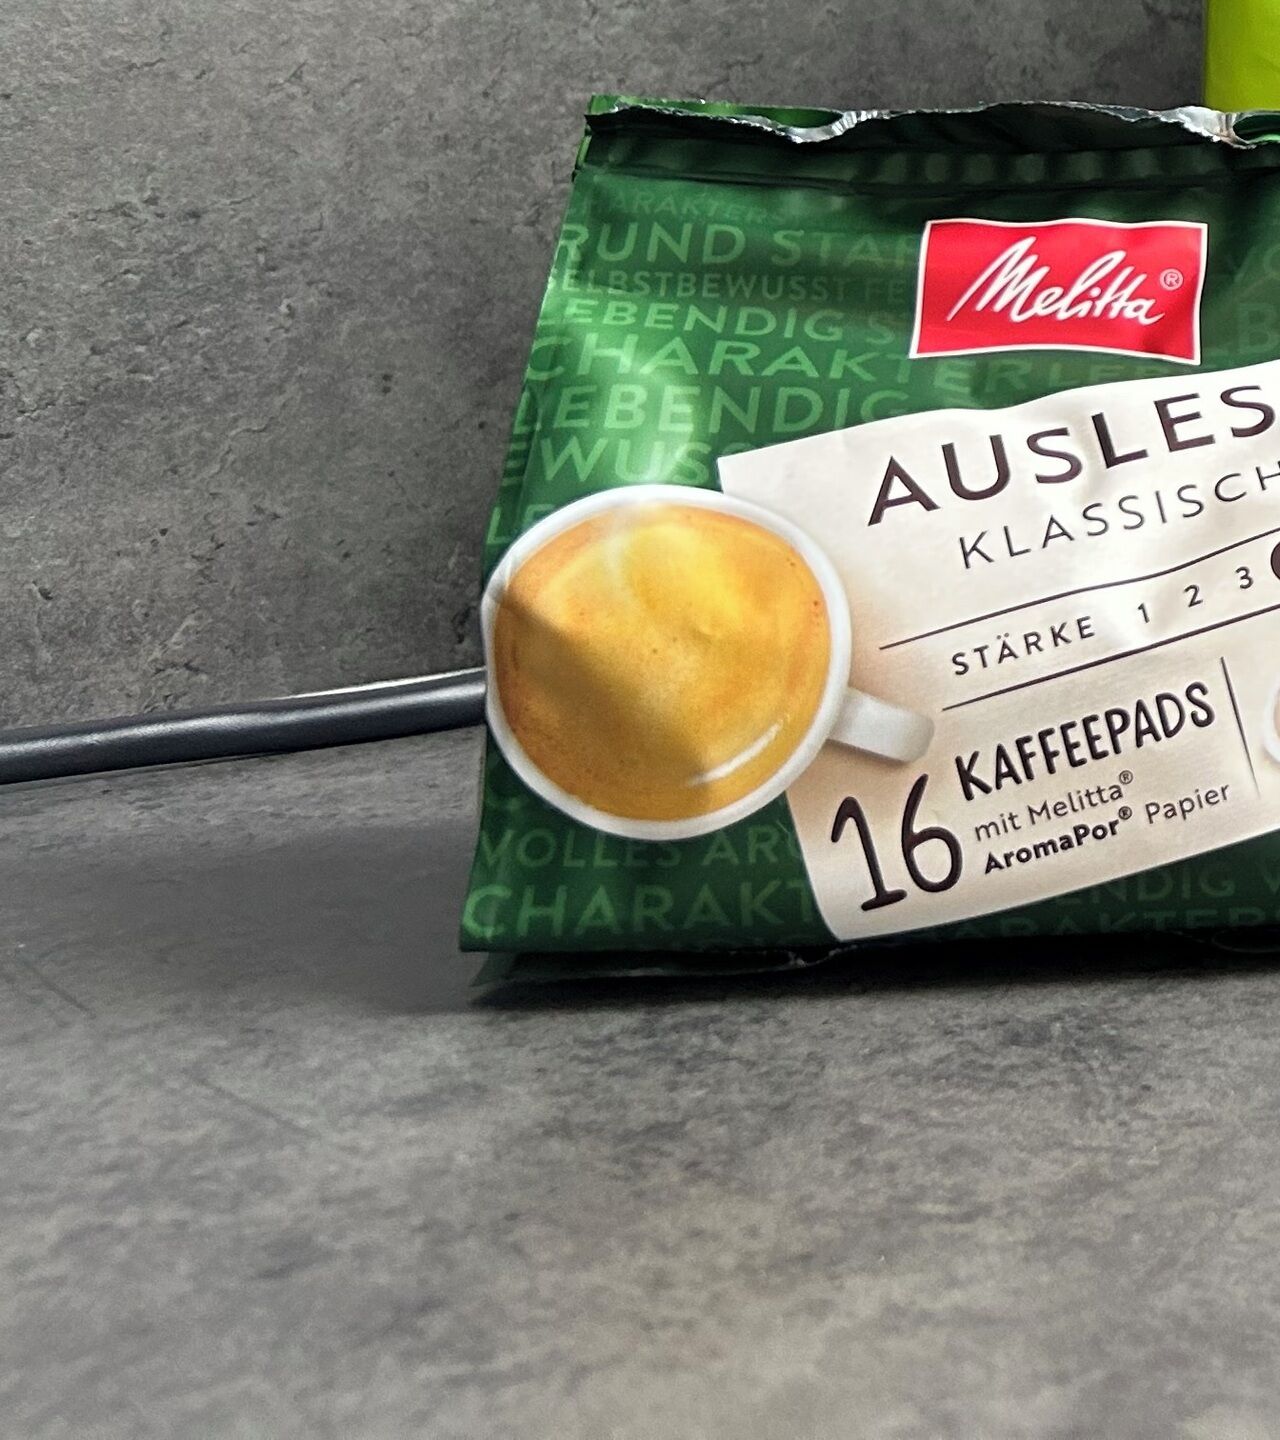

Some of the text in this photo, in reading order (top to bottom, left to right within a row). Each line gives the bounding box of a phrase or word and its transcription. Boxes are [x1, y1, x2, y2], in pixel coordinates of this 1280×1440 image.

[951, 616, 1096, 676] STÄRKE
[1137, 603, 1151, 624] 1
[1184, 584, 1204, 608] 2
[1235, 566, 1255, 589] 3
[955, 680, 1216, 802] KAFFEEPADS
[831, 773, 963, 912] 16
[975, 812, 1021, 842] mit
[1145, 784, 1231, 824] Papier
